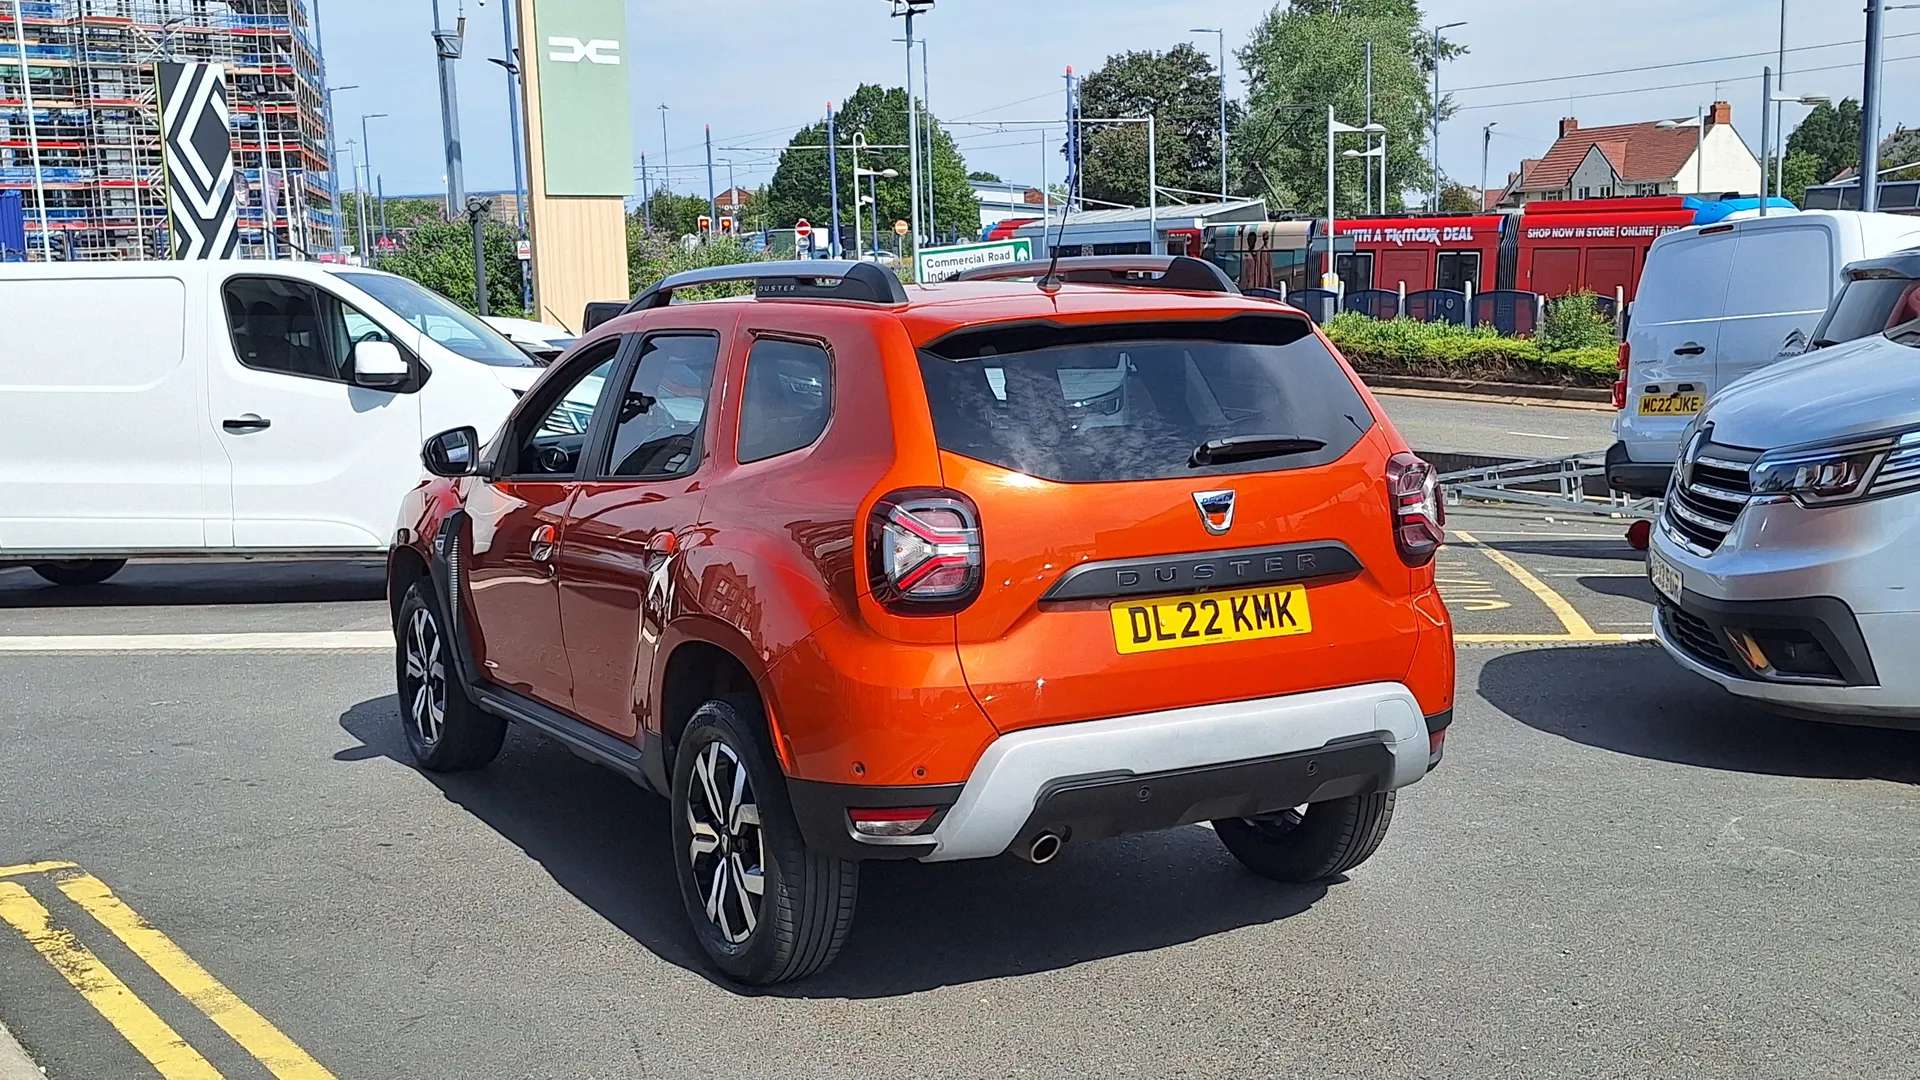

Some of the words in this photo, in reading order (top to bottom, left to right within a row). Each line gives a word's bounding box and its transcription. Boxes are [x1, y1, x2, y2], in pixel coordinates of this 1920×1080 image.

[1373, 228, 1382, 242] A
[1443, 226, 1473, 241] DEAL
[1527, 228, 1551, 239] SHOP
[1552, 228, 1576, 238] NOW
[1576, 227, 1585, 237] IN
[1586, 226, 1615, 238] STORE
[1621, 226, 1654, 237] ONLINE
[926, 253, 985, 269] Commercial
[988, 250, 1011, 262] Road
[758, 284, 796, 292] DUSTER
[1643, 397, 1673, 413] MC22
[1674, 396, 1699, 412] JKE
[1116, 553, 1317, 587] DUSTER
[1128, 599, 1223, 644] DL22
[1230, 592, 1297, 632] KMK
